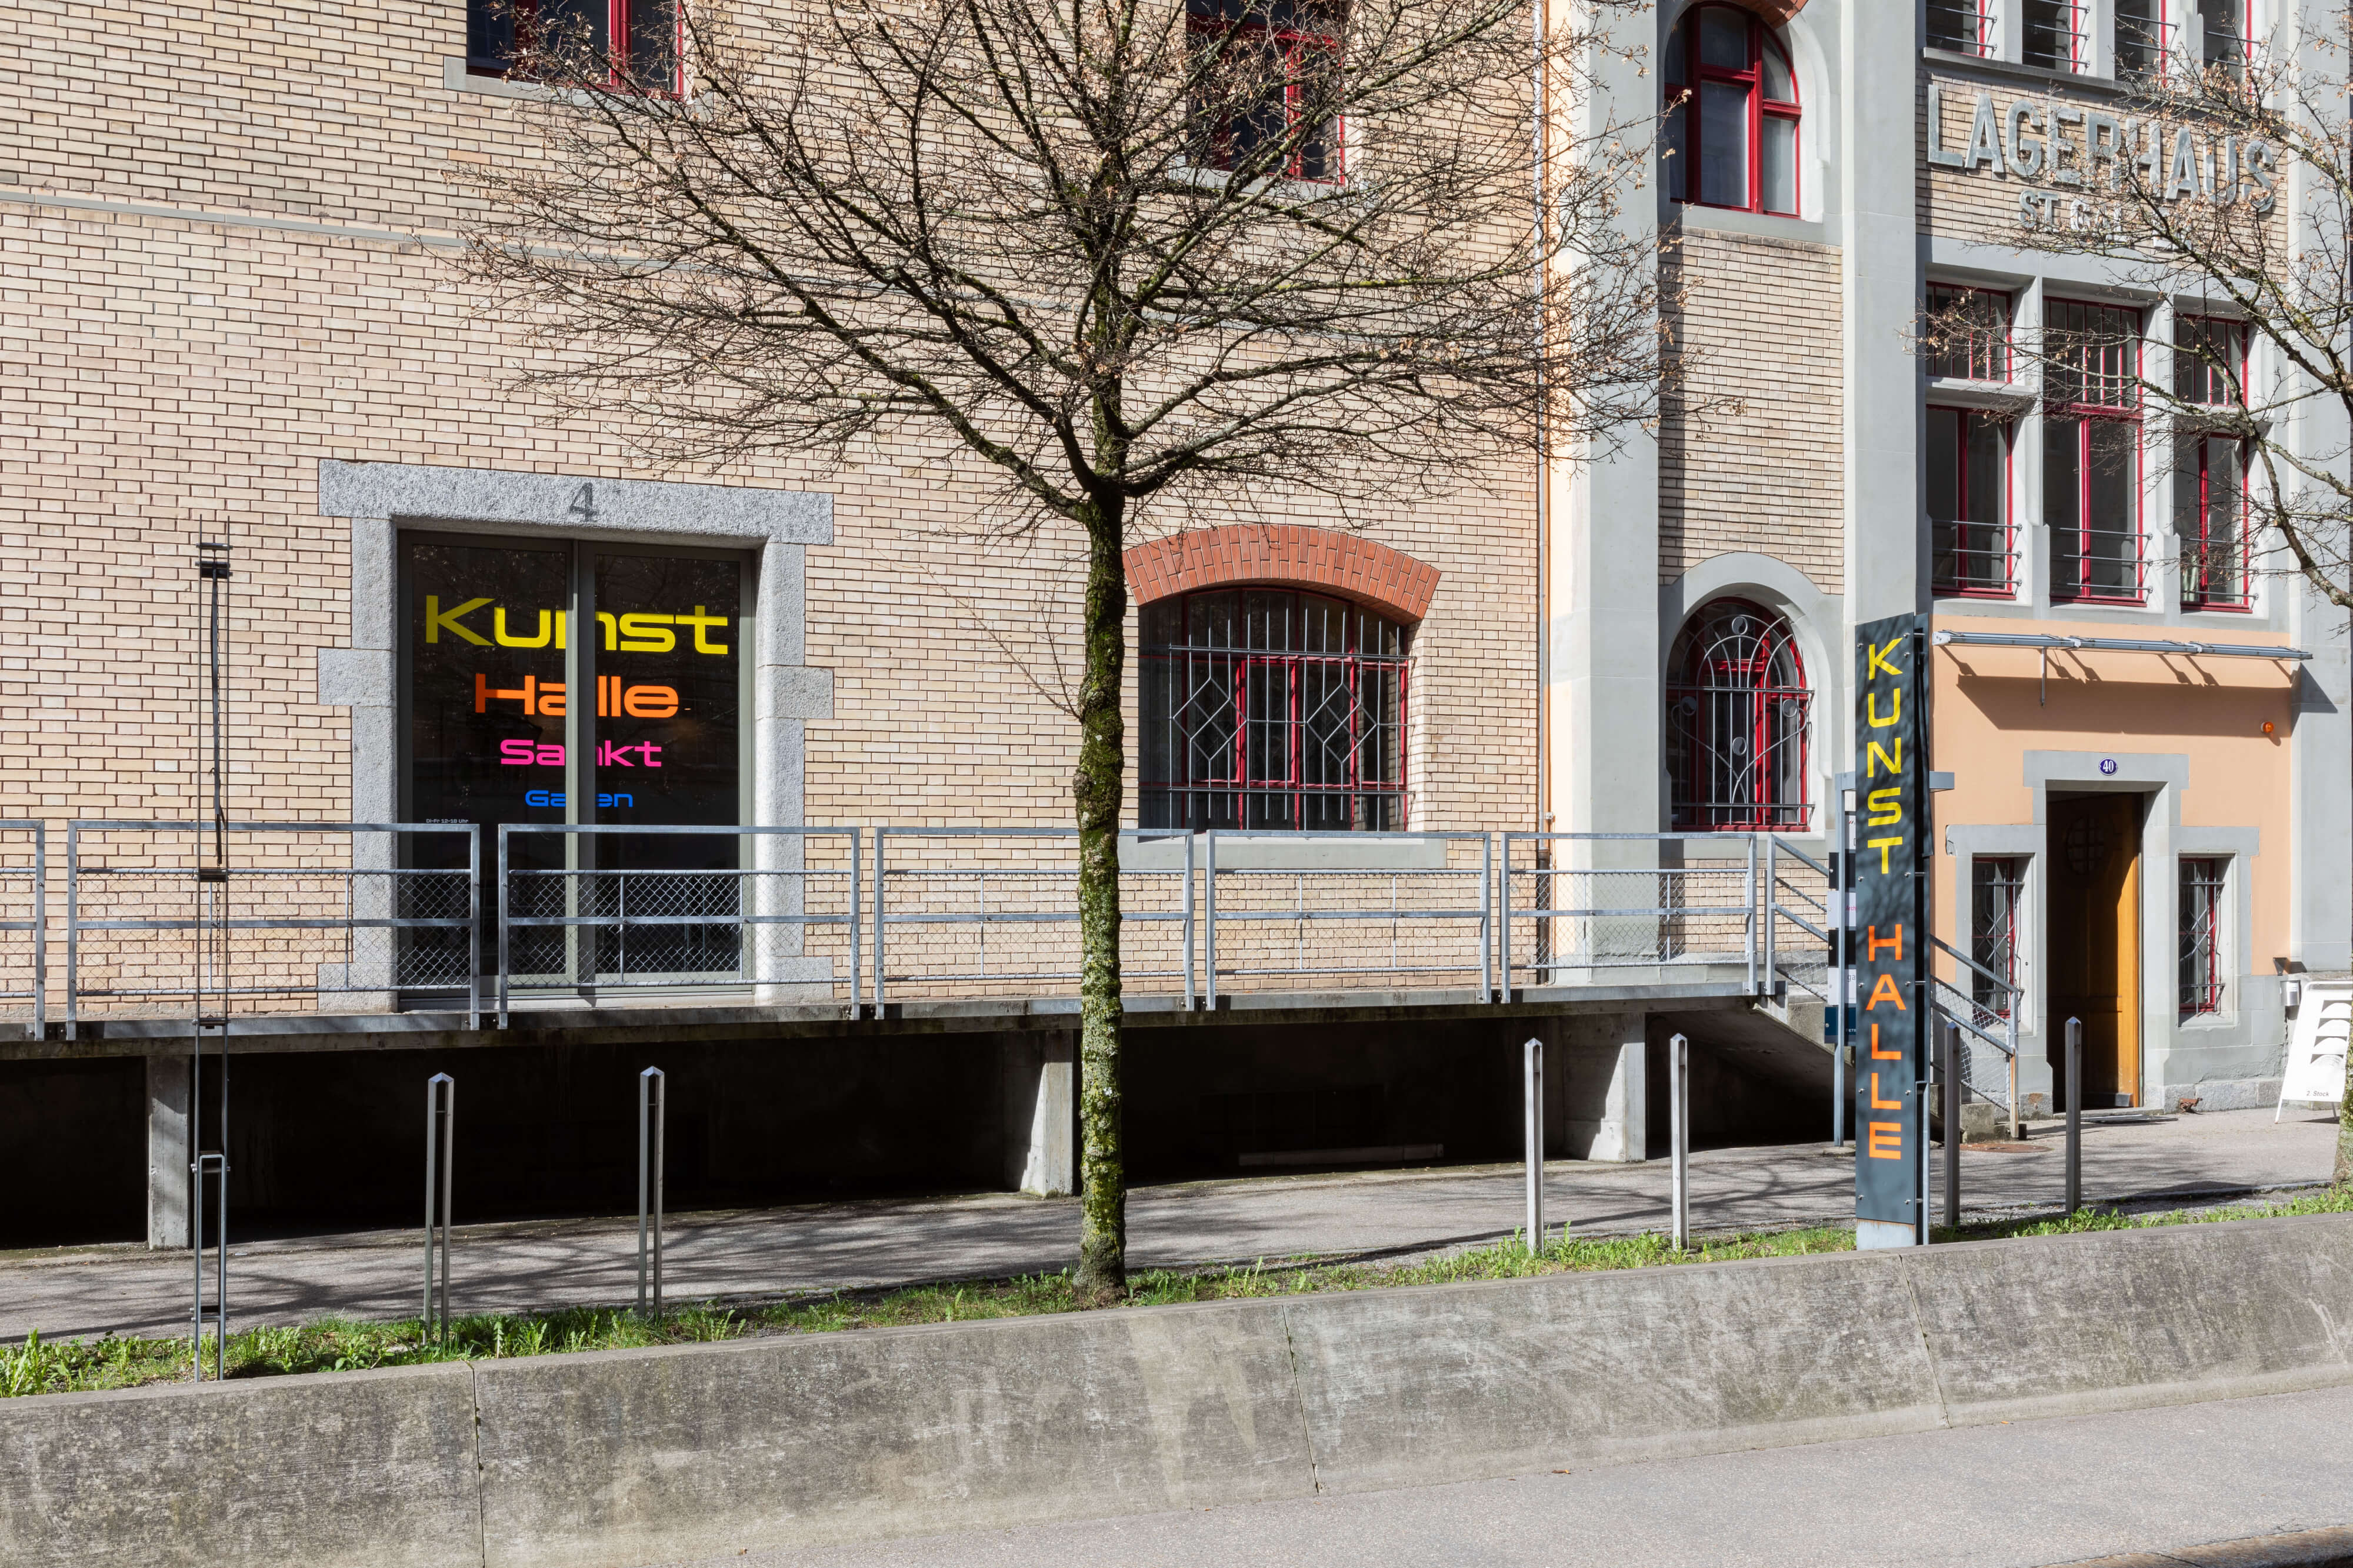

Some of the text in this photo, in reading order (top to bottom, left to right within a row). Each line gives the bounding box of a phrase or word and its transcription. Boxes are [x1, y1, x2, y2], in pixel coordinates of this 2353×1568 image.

[1927, 84, 2275, 213] LAGERHAUS
[569, 482, 599, 522] 4
[425, 595, 728, 655] Kunst
[499, 739, 662, 768] Sakt
[2103, 760, 2114, 772] 40
[525, 789, 634, 808] Gaen
[1865, 637, 1907, 1160] KUNST HALLE
